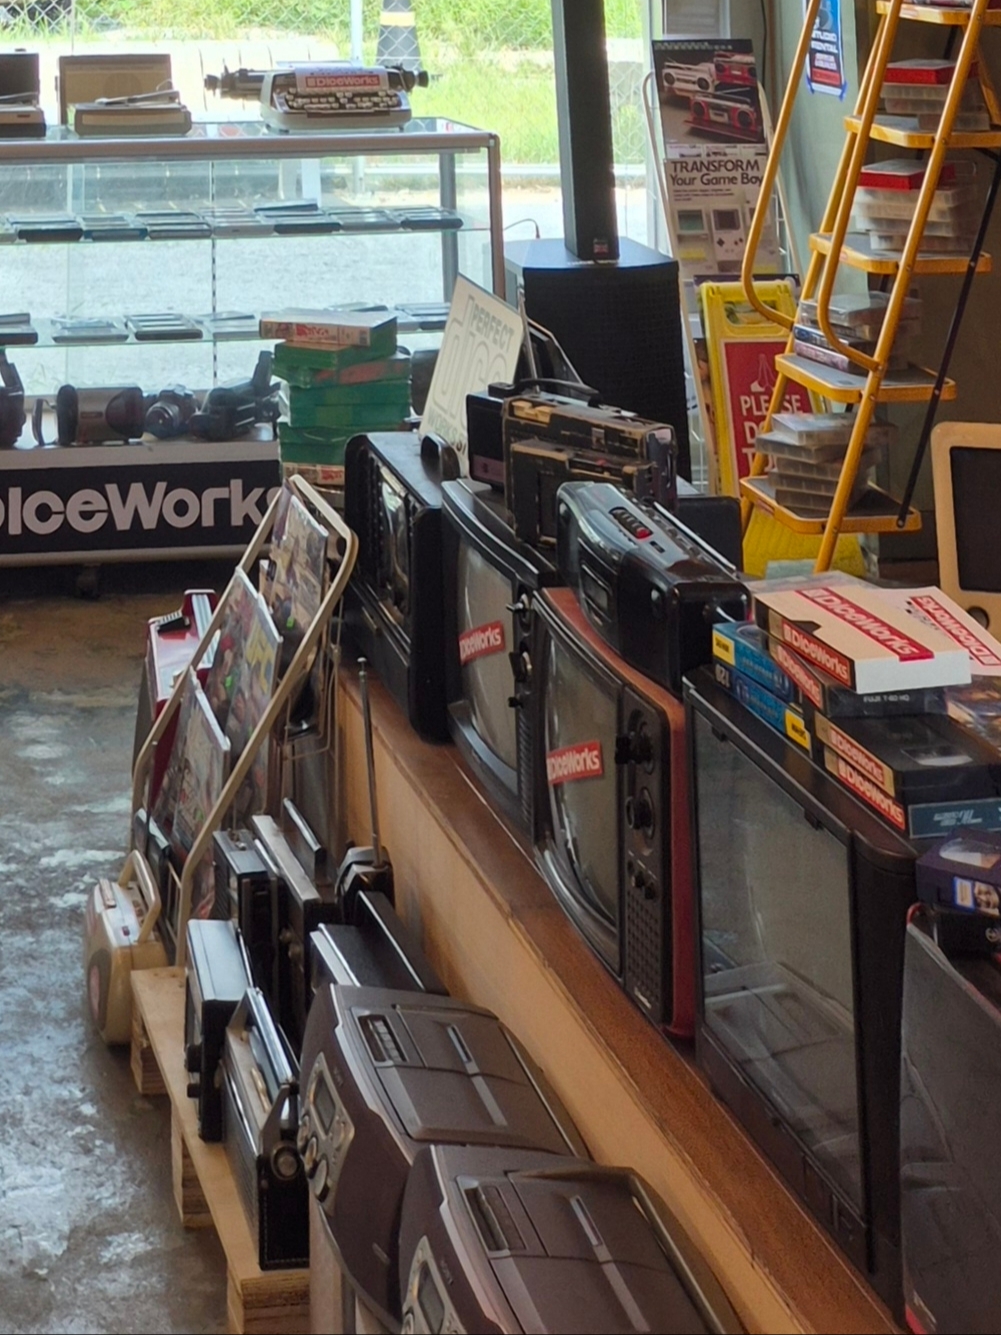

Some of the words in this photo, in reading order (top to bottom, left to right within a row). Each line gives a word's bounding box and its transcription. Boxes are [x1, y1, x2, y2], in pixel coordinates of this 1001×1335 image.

[671, 159, 760, 174] TRANSFORM
[670, 173, 697, 187] Your
[700, 173, 738, 186] Game
[741, 172, 764, 188] Boy
[470, 304, 515, 354] PERFECT
[740, 394, 803, 417] PLESE
